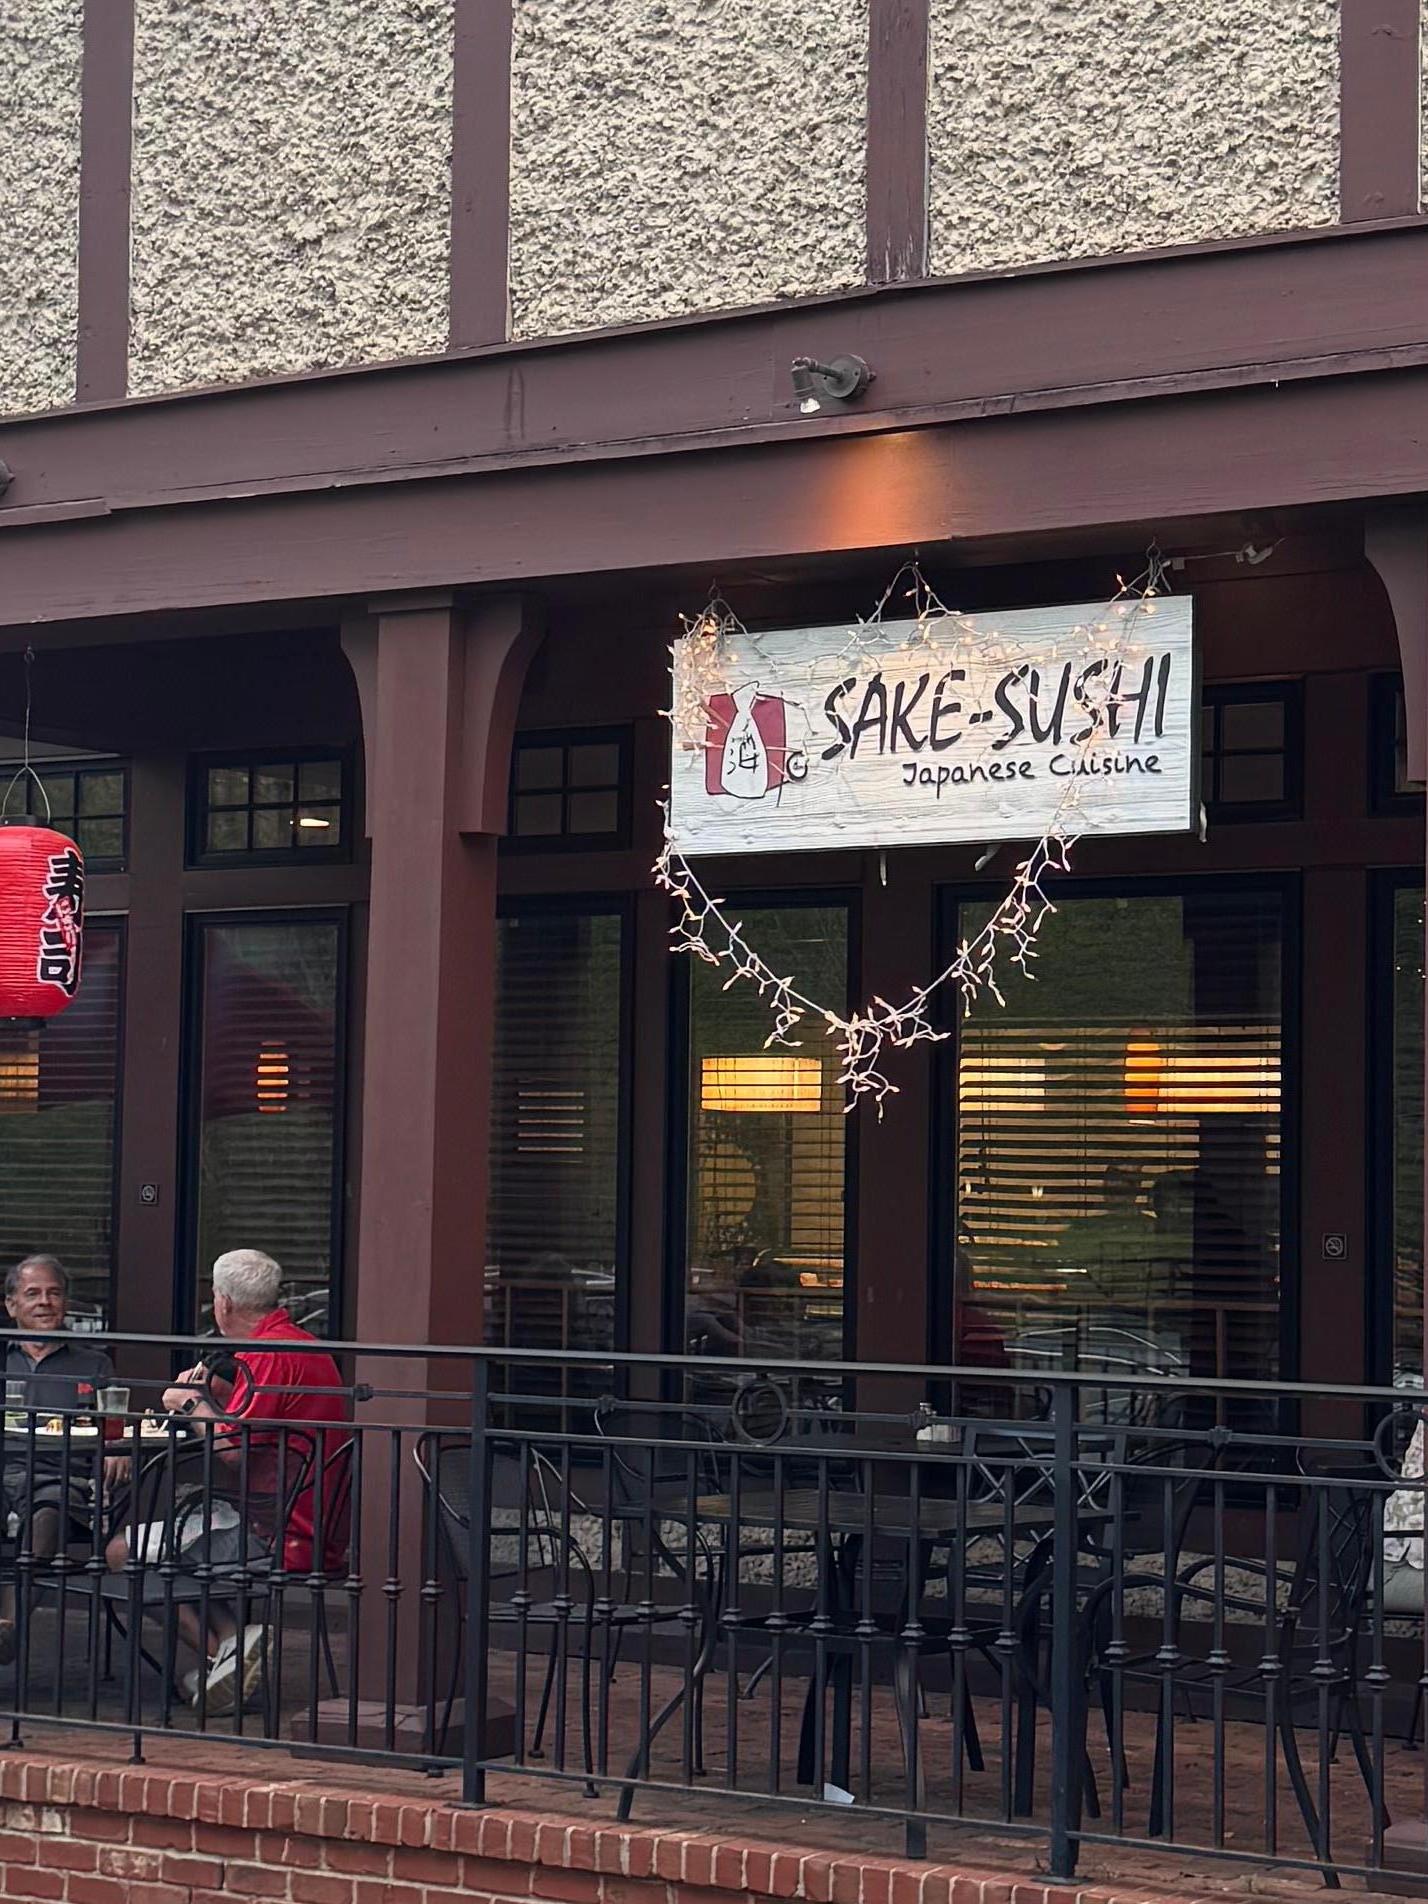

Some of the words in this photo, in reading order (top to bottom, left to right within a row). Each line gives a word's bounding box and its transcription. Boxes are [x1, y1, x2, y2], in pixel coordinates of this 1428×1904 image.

[821, 652, 1172, 760] SAKE-SUSHI
[902, 761, 1036, 799] Japanese
[1049, 752, 1164, 777] Cuisine
